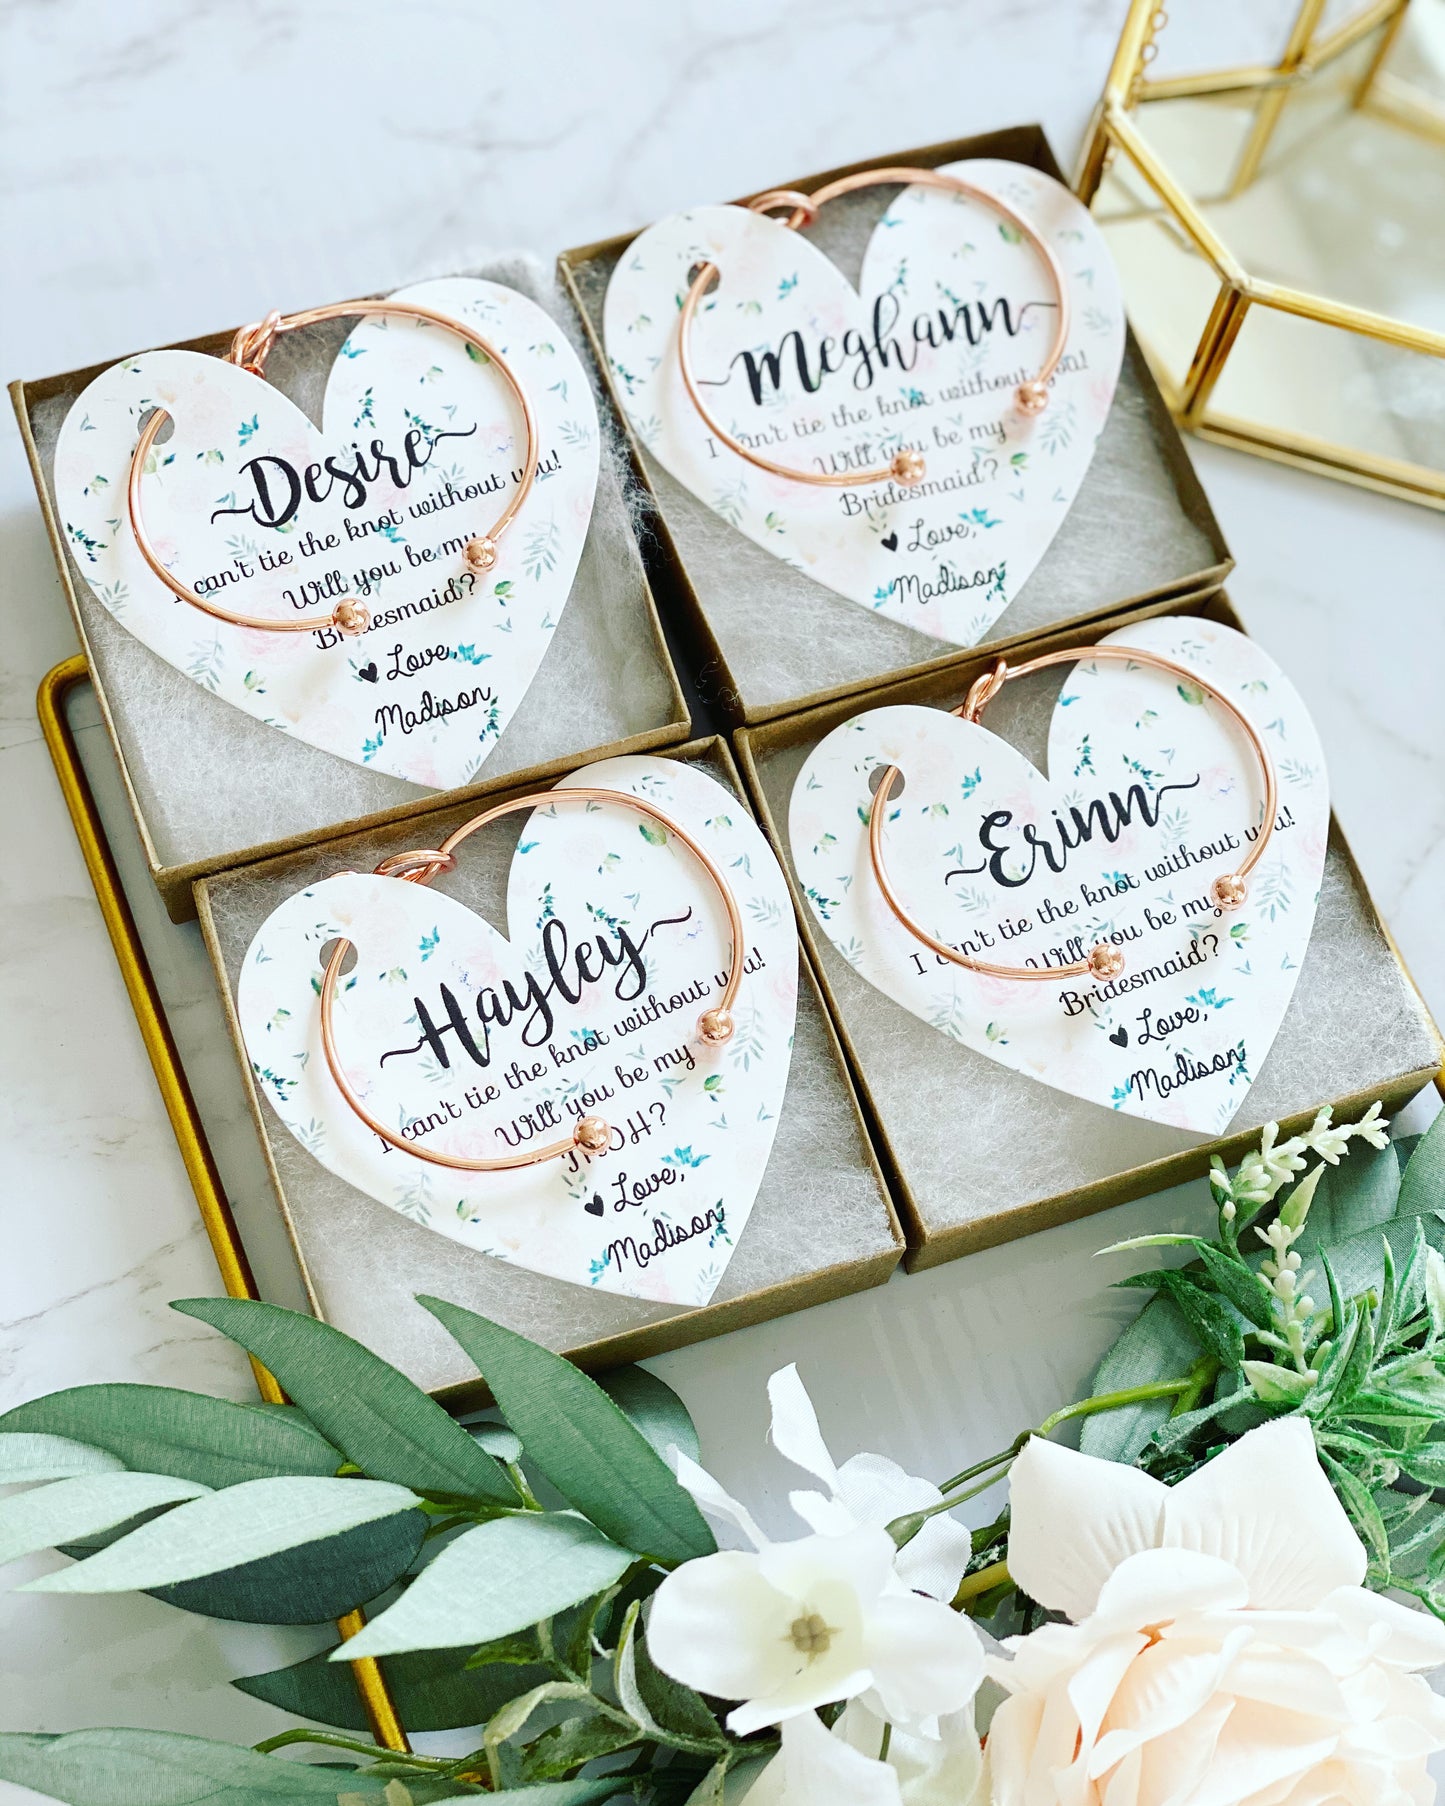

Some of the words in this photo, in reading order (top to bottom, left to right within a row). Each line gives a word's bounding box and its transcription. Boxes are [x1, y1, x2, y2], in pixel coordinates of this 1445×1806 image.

[697, 294, 1057, 405] Meghann
[705, 438, 719, 458] I
[740, 423, 788, 449] an't
[793, 417, 825, 438] tie
[832, 404, 872, 428] the
[877, 391, 934, 417] knot
[939, 366, 1034, 402] without
[211, 422, 477, 531] Desire
[813, 442, 876, 475] Will
[932, 426, 962, 448] be
[969, 421, 1007, 444] my
[840, 458, 998, 516] Bridesmaid?
[194, 560, 254, 595] can't
[259, 550, 294, 572] tie
[299, 531, 341, 557] the
[344, 509, 404, 542] knot
[408, 473, 506, 518] without
[908, 519, 976, 551] Love,
[283, 570, 348, 610] Will
[353, 560, 401, 597] you
[404, 544, 437, 568] be
[893, 565, 1003, 603] Madison
[387, 643, 458, 681] Love,
[375, 686, 492, 737] Madison
[945, 774, 1200, 888] Erinn
[910, 952, 928, 975] I
[936, 929, 995, 965] cn't
[998, 918, 1033, 940] tie
[1037, 898, 1079, 924] the
[1081, 873, 1140, 907] knot
[1144, 833, 1240, 882] without
[1094, 925, 1143, 946] ou
[1144, 908, 1177, 932] be
[380, 906, 692, 1068] Hayley
[1059, 933, 1220, 1017] Bridesmaid?
[1136, 1007, 1208, 1046] Love,
[401, 1101, 462, 1141] can't
[464, 1086, 501, 1109] tie
[504, 1062, 548, 1090] the
[548, 1030, 610, 1068] knot
[614, 980, 711, 1037] without
[1131, 1047, 1246, 1101] Madison
[495, 1100, 562, 1147] Will
[565, 1085, 615, 1121] you
[615, 1065, 649, 1089] be
[654, 1044, 696, 1073] my
[611, 1168, 685, 1213] Love,
[608, 1207, 725, 1273] Madison
